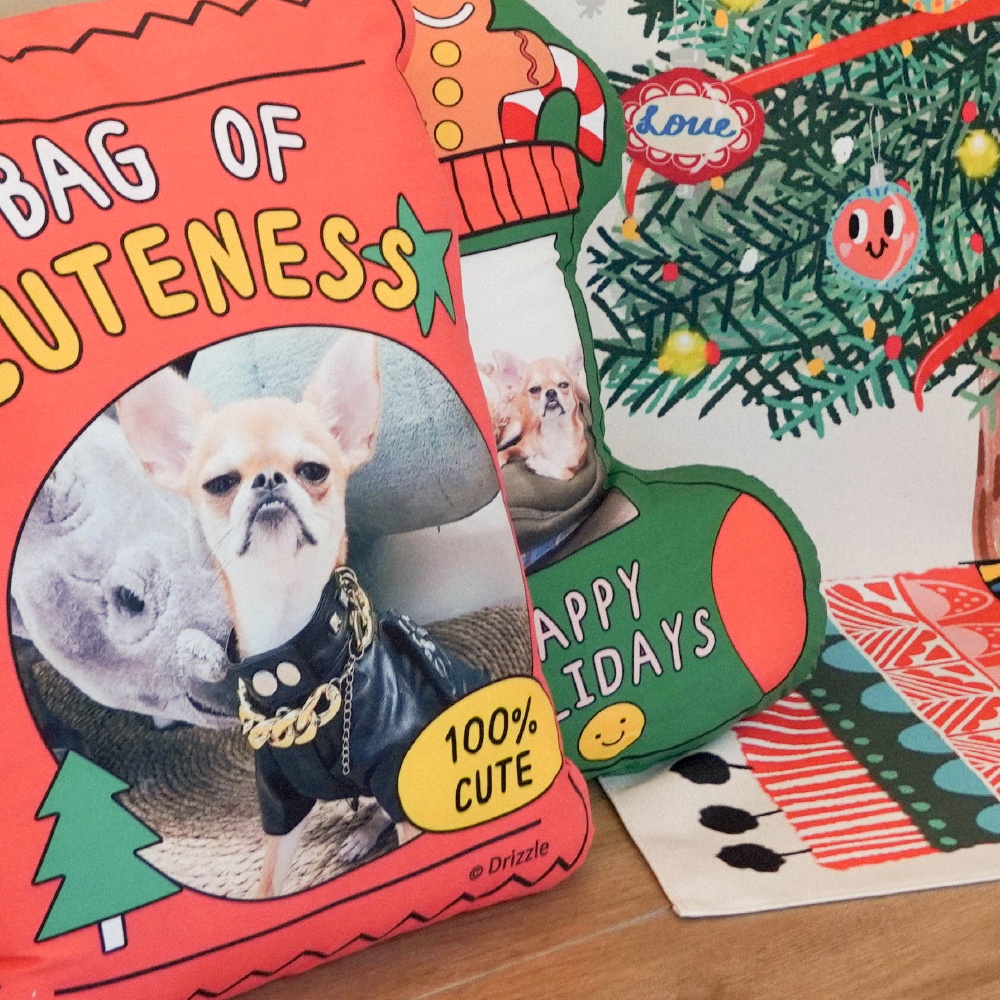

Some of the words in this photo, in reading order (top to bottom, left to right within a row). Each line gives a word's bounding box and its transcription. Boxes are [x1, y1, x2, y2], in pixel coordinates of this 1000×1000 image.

[0, 118, 160, 239] BAG
[210, 102, 306, 184] OF
[532, 558, 641, 663] APPY
[555, 607, 717, 724] IDAYS
[445, 696, 538, 764] 100%
[455, 750, 534, 813] CUTE
[488, 839, 550, 874] Drizzle
